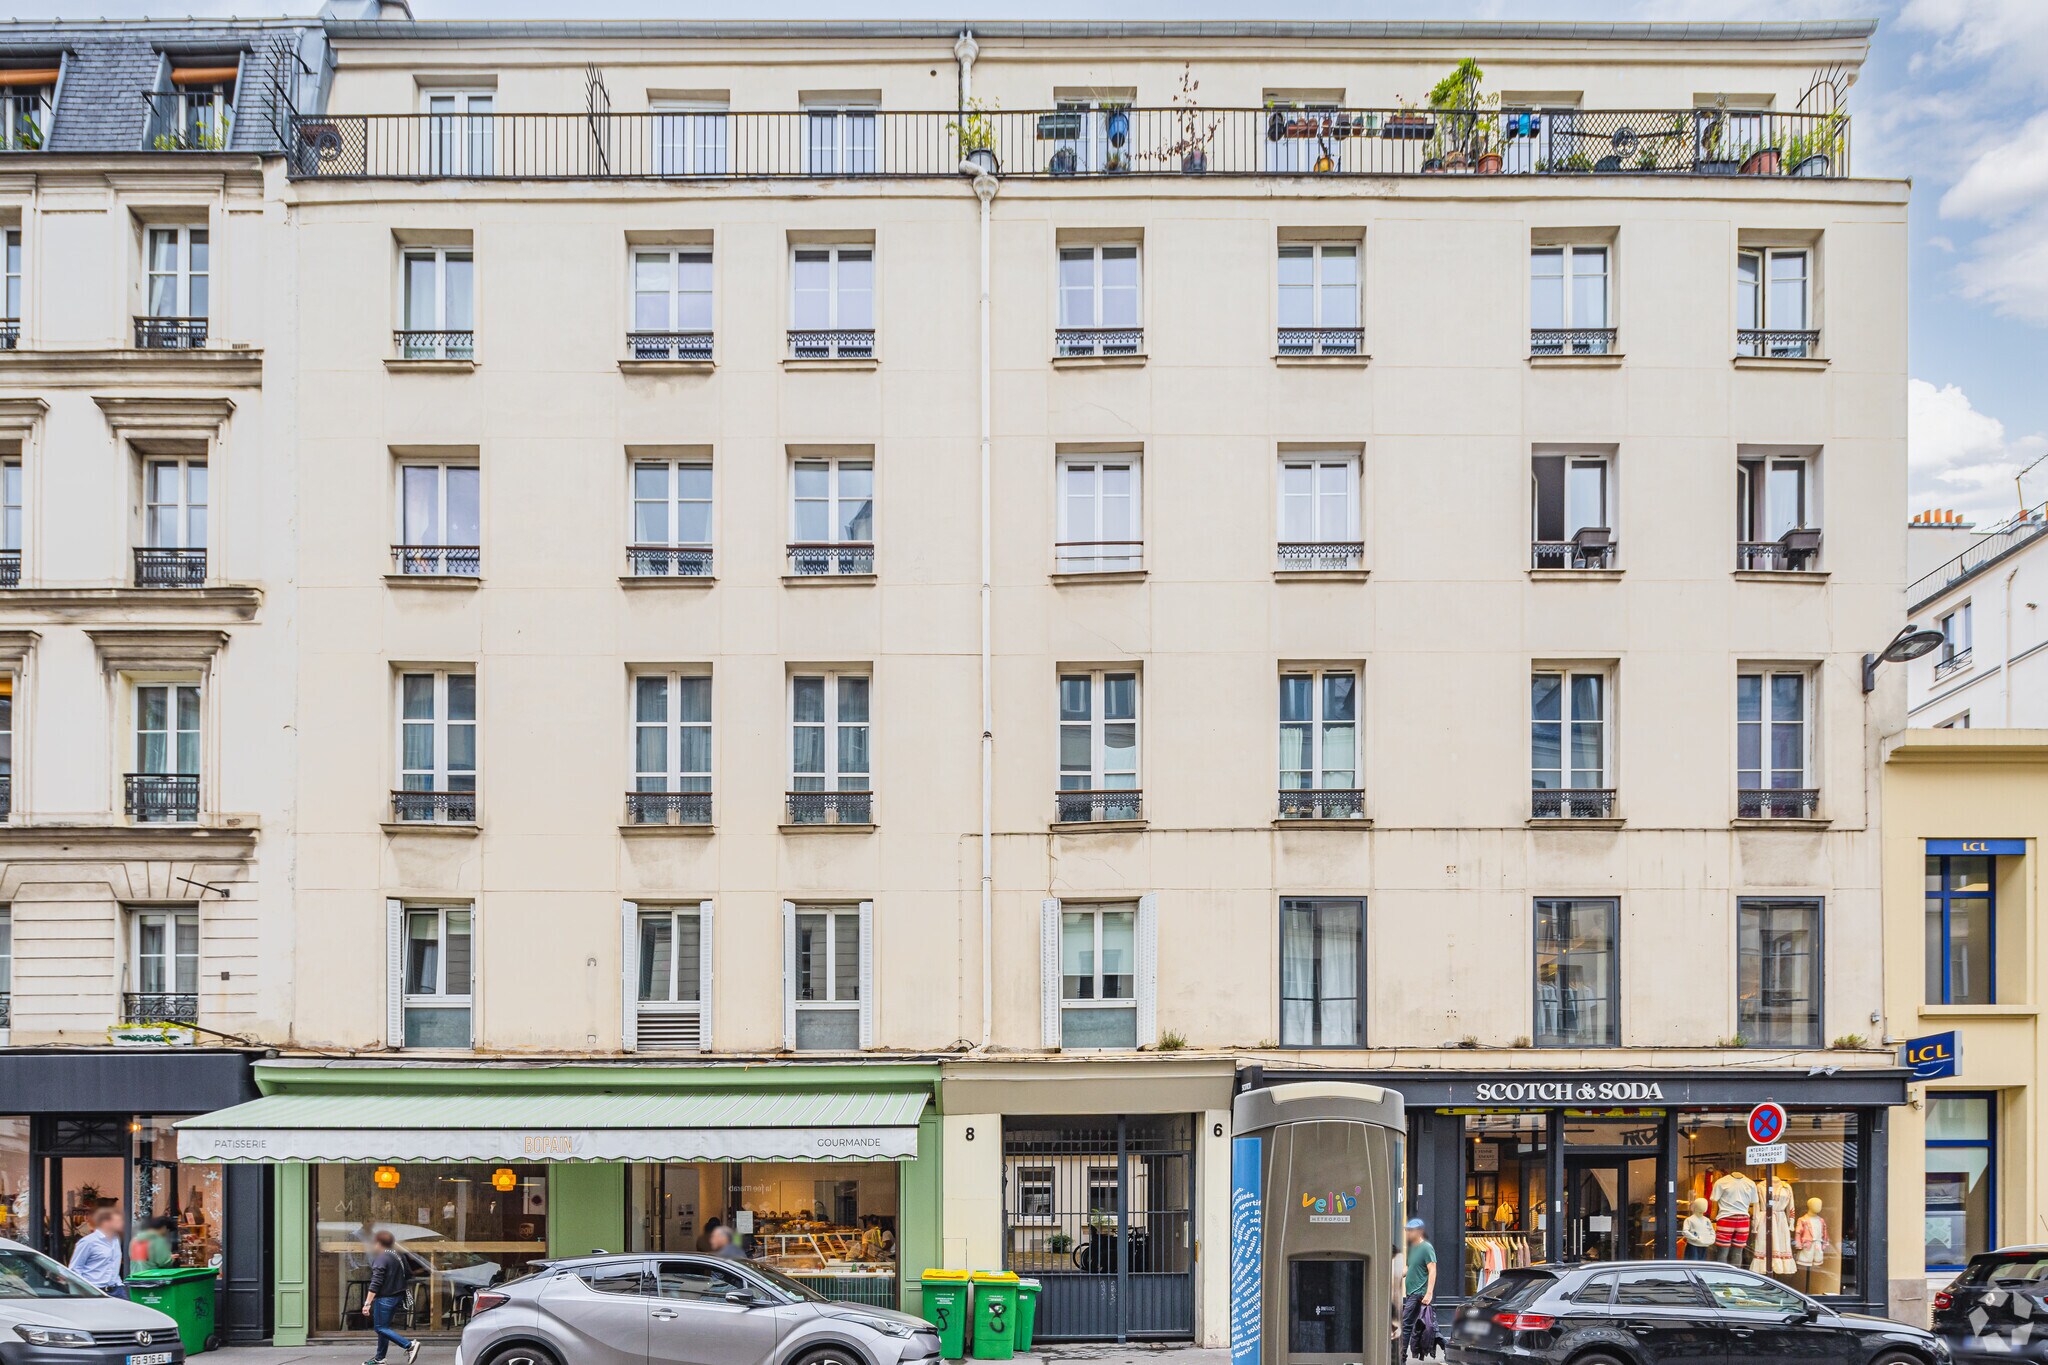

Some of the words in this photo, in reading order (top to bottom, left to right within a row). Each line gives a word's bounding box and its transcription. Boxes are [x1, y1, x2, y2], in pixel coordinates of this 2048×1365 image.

[1963, 842, 1989, 851] LCL
[1909, 1044, 1950, 1063] LCL
[1476, 1083, 1573, 1100] SCOTCH
[1575, 1082, 1596, 1100] &
[1598, 1082, 1664, 1100] SODA
[965, 1127, 975, 1141] 8
[1213, 1123, 1222, 1137] 6
[214, 1139, 267, 1148] PATISSERIE
[524, 1136, 573, 1153] BOPAIN
[817, 1138, 881, 1147] GOURMANDE
